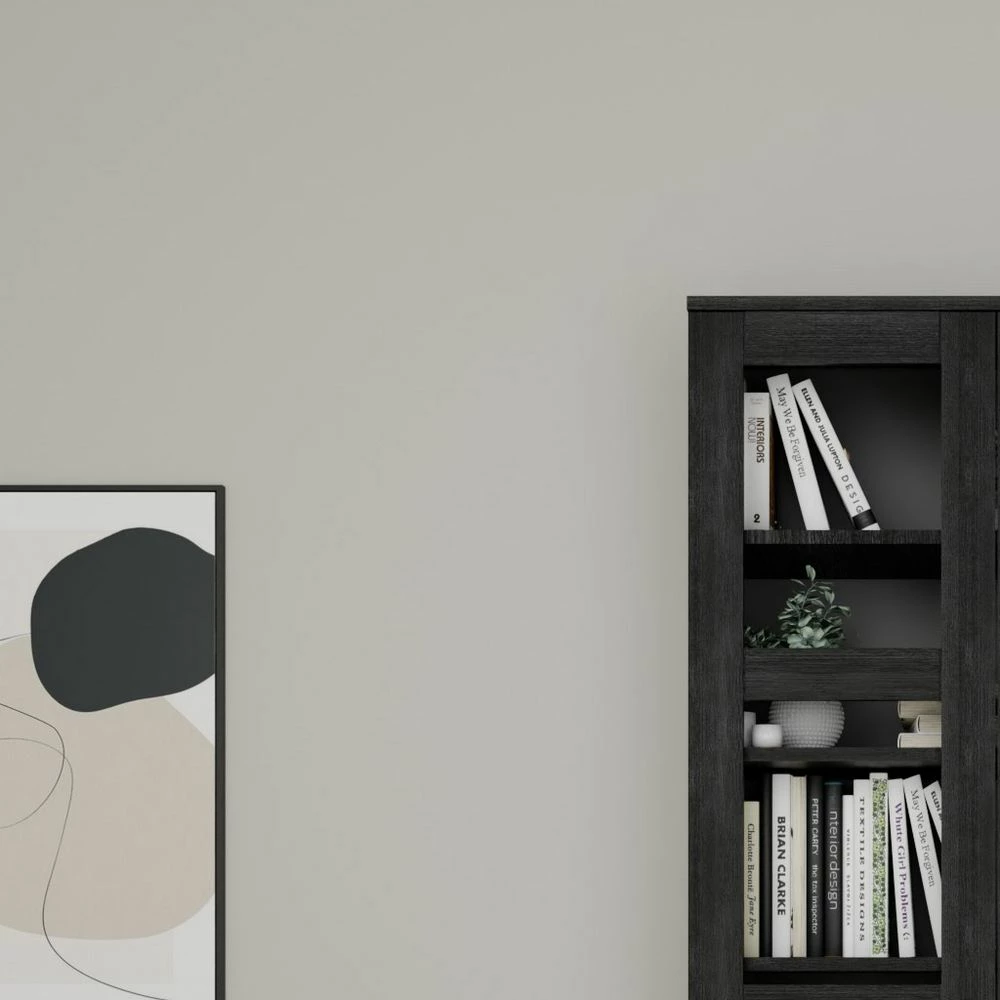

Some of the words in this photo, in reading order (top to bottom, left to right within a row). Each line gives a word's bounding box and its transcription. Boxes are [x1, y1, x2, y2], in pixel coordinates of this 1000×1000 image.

[776, 386, 788, 406] May
[782, 408, 792, 424] We
[756, 417, 765, 464] INTERIORS
[786, 424, 797, 438] Be
[810, 408, 821, 423] AND
[826, 443, 843, 471] LUPTON
[789, 439, 807, 478] Forgiven
[753, 514, 761, 523] 2
[747, 823, 755, 862] Charlotte
[777, 816, 786, 859] BRIAN
[910, 789, 920, 812] May
[922, 846, 936, 887] Forgiven
[777, 864, 786, 915] CLARKE
[898, 874, 909, 929] Problems
